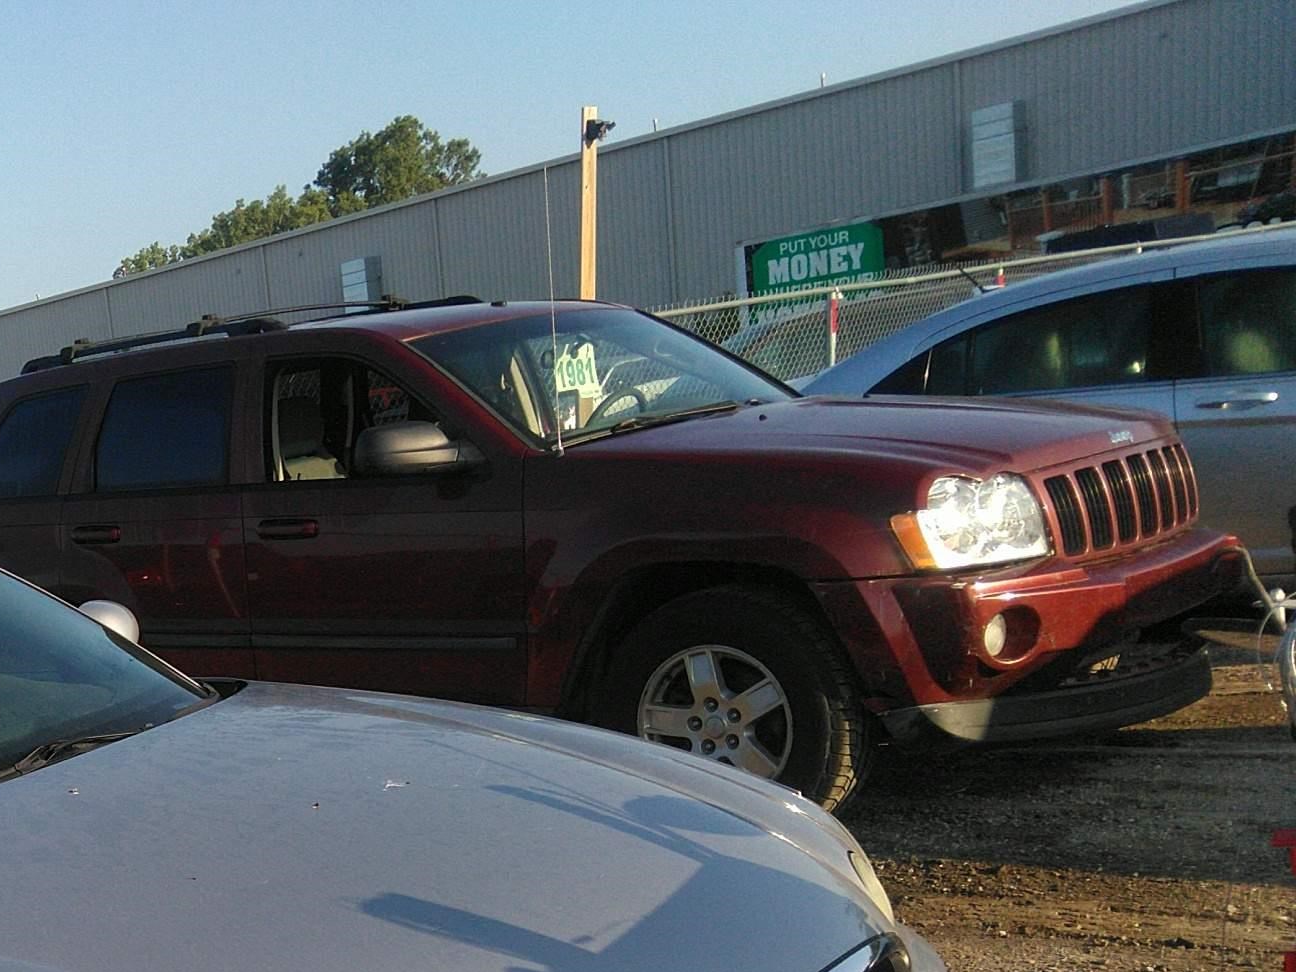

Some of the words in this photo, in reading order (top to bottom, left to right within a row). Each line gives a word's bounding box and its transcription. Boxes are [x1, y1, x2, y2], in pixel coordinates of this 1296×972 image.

[779, 238, 807, 256] PUT
[808, 230, 850, 249] YOUR
[767, 242, 865, 286] MONEY
[556, 357, 595, 388] 1981
